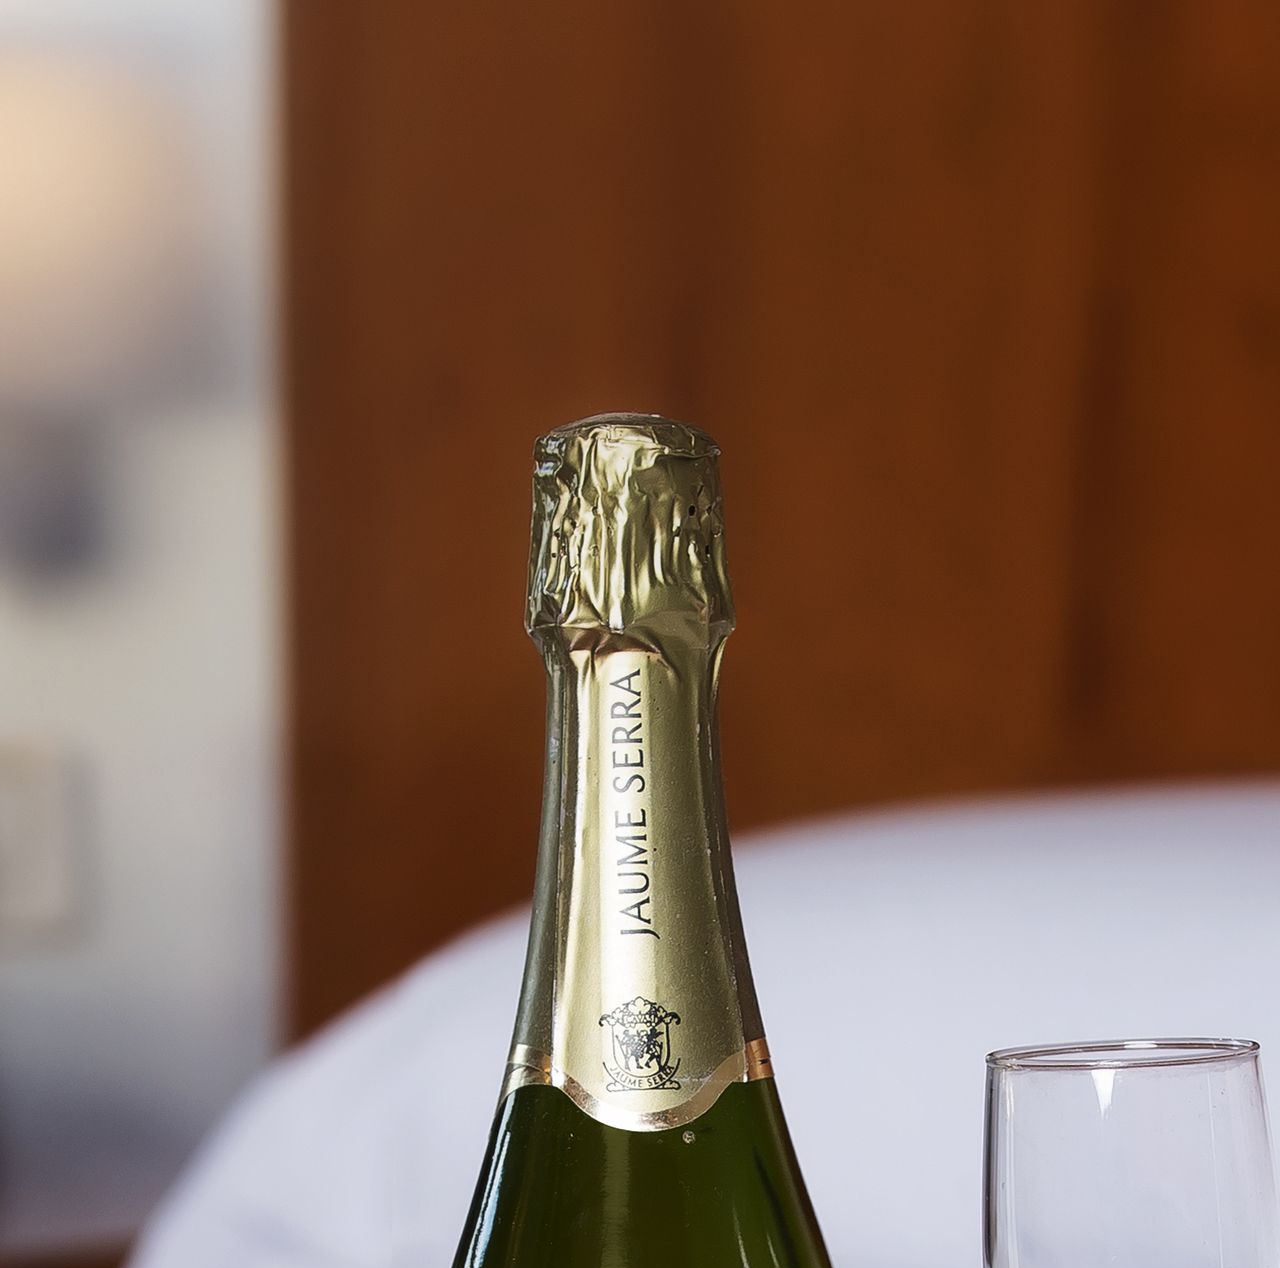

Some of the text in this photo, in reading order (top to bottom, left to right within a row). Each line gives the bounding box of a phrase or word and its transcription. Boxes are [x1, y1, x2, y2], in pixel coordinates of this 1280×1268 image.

[609, 667, 661, 940] JAUME SERRA
[609, 1066, 644, 1088] JAUME
